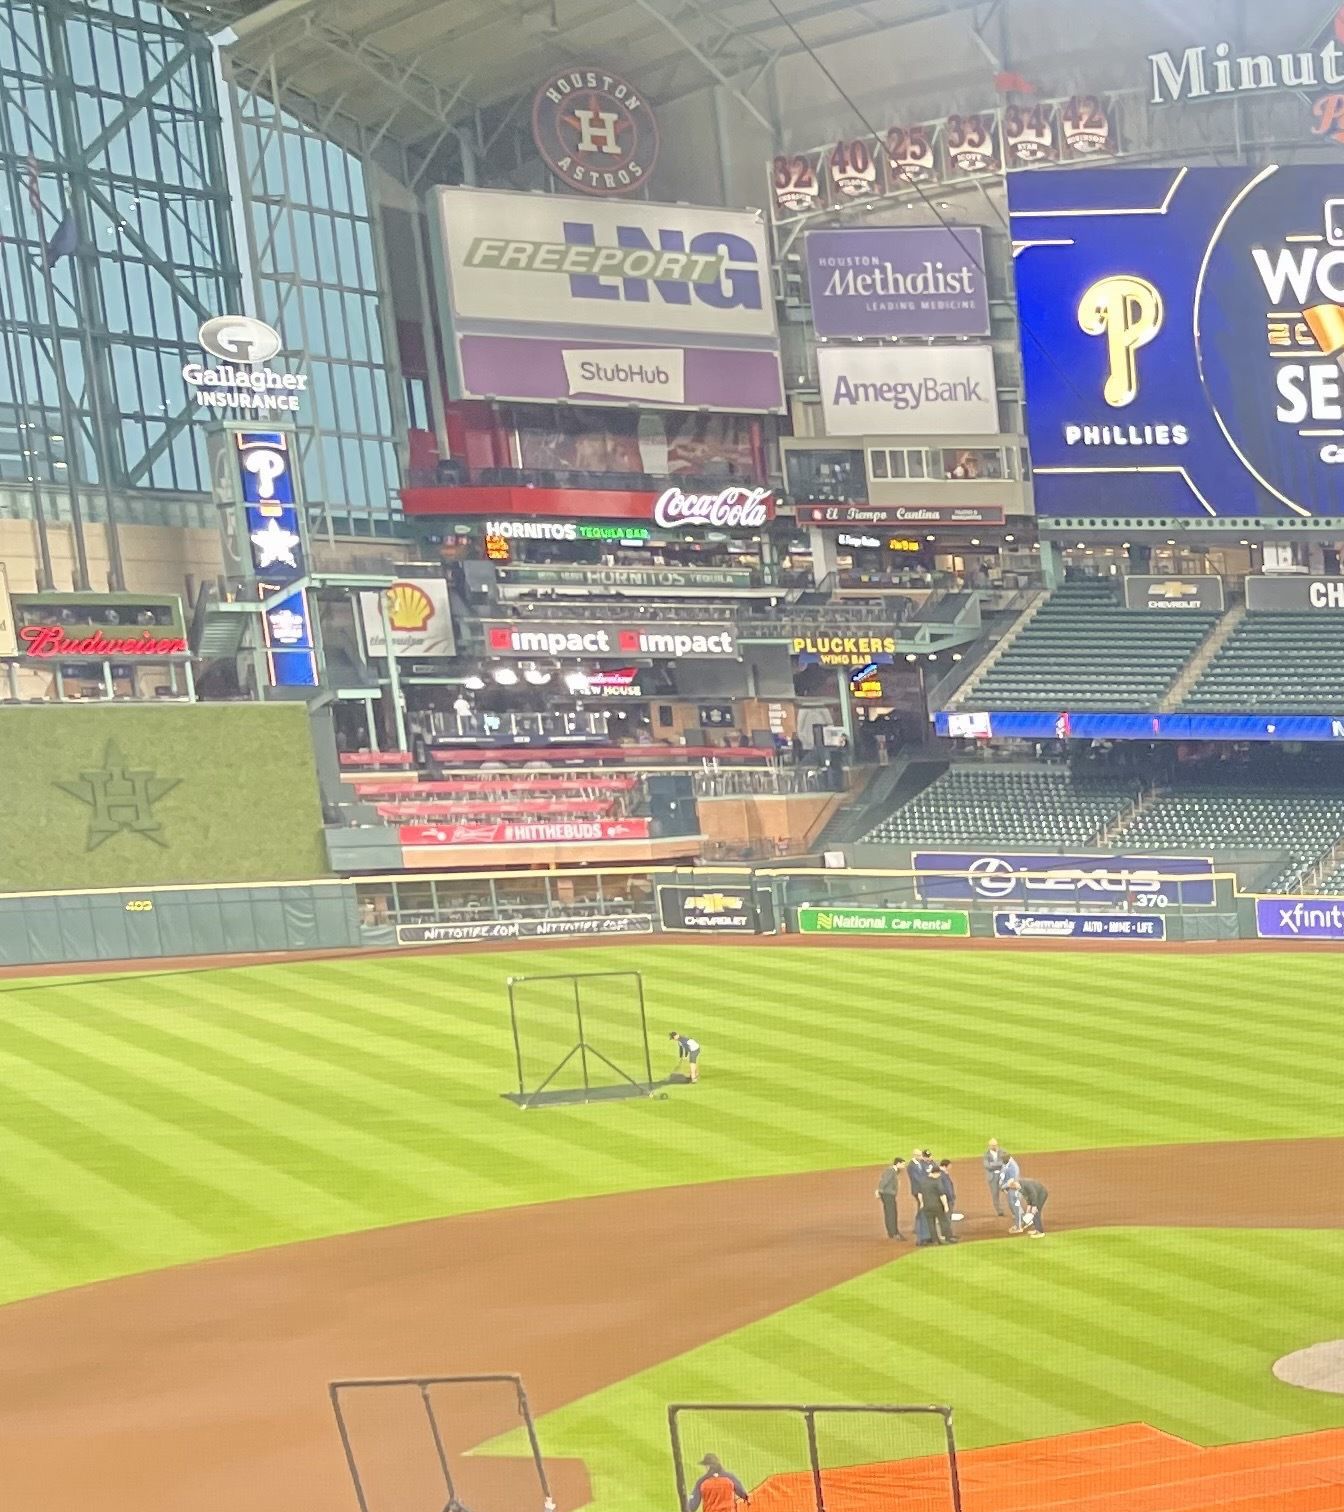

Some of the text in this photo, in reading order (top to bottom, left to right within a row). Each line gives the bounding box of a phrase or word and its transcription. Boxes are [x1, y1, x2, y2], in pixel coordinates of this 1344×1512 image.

[546, 72, 641, 110] HOUSTON
[1006, 105, 1046, 138] 34
[1063, 95, 1105, 129] 42
[575, 109, 621, 154] H
[887, 126, 929, 160] 25
[948, 114, 986, 148] 33
[774, 156, 812, 188] 32
[831, 140, 869, 174] 40
[558, 157, 642, 188] ASTROS
[472, 240, 716, 281] FREEPORT
[563, 222, 762, 310] LNG
[819, 256, 880, 267] HOUSTON
[823, 262, 974, 296] Methodist
[866, 300, 976, 312] LEADING MEDICINE
[1078, 275, 1163, 407] P
[182, 363, 307, 392] Gallagher
[580, 362, 669, 384] StubHub
[197, 391, 300, 411] INSURANCE
[833, 376, 980, 410] AmegyBank
[1066, 425, 1188, 446] PHILLIES
[826, 507, 838, 520] El
[847, 508, 887, 522] Tiempo
[897, 508, 940, 520] Cantina
[486, 522, 577, 540] HORNITOS
[587, 571, 685, 586] HORNITOS
[20, 626, 188, 656] Budweiser
[512, 629, 733, 656] impact impact
[793, 637, 896, 653] PLUCKERS
[1137, 894, 1168, 907] 370
[833, 915, 951, 931] National Car Rental
[1083, 920, 1104, 933] AUTO
[1137, 922, 1154, 934] LIFE
